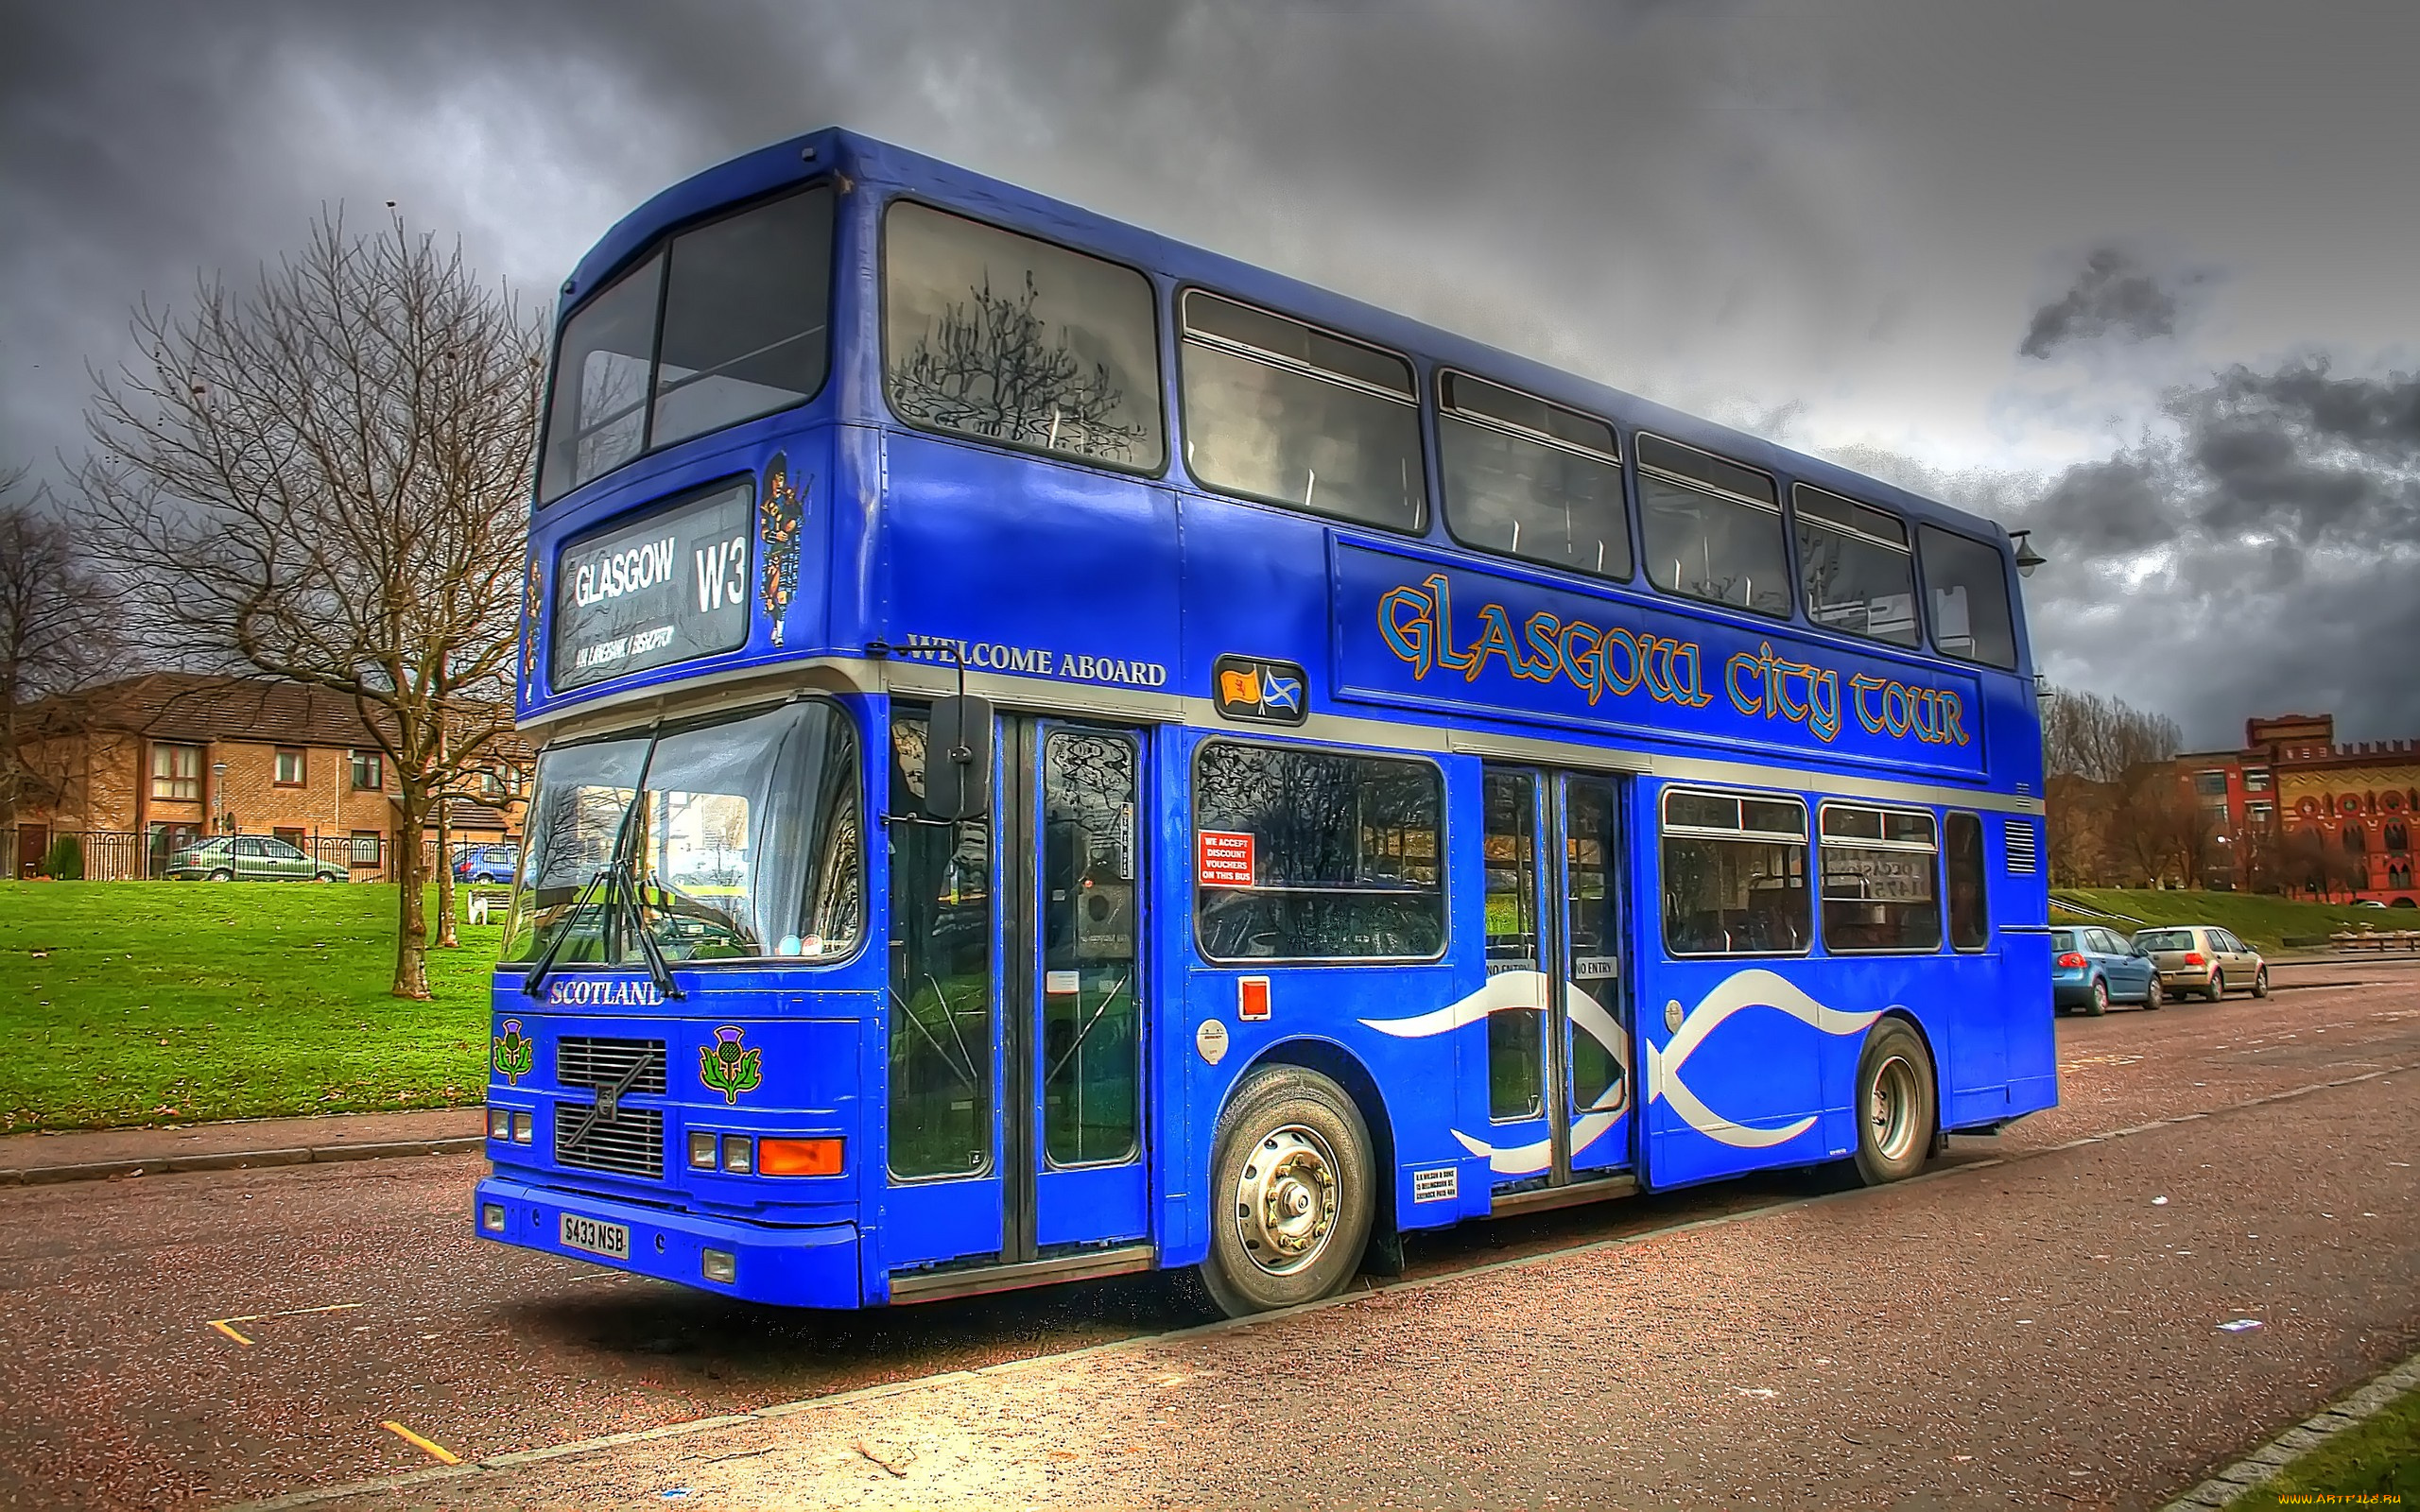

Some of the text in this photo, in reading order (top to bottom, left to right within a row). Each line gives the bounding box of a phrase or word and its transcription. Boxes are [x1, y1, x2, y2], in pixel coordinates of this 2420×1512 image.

[575, 537, 676, 608] GLASGOW
[696, 537, 746, 613] W3
[1377, 573, 1713, 707] GLASGOW
[907, 632, 1167, 687] WELCOME ABOARD
[1204, 837, 1248, 848] WE ACCEPT
[1206, 849, 1246, 859] DISCOUNT
[1205, 859, 1248, 869] VOUCHERS
[1202, 870, 1251, 881] ON THIS BUS
[1486, 964, 1499, 975] NO
[1577, 962, 1612, 974] NO ENTRY
[550, 981, 665, 1005] SCOTLAND
[566, 1217, 623, 1251] S433 NSB
